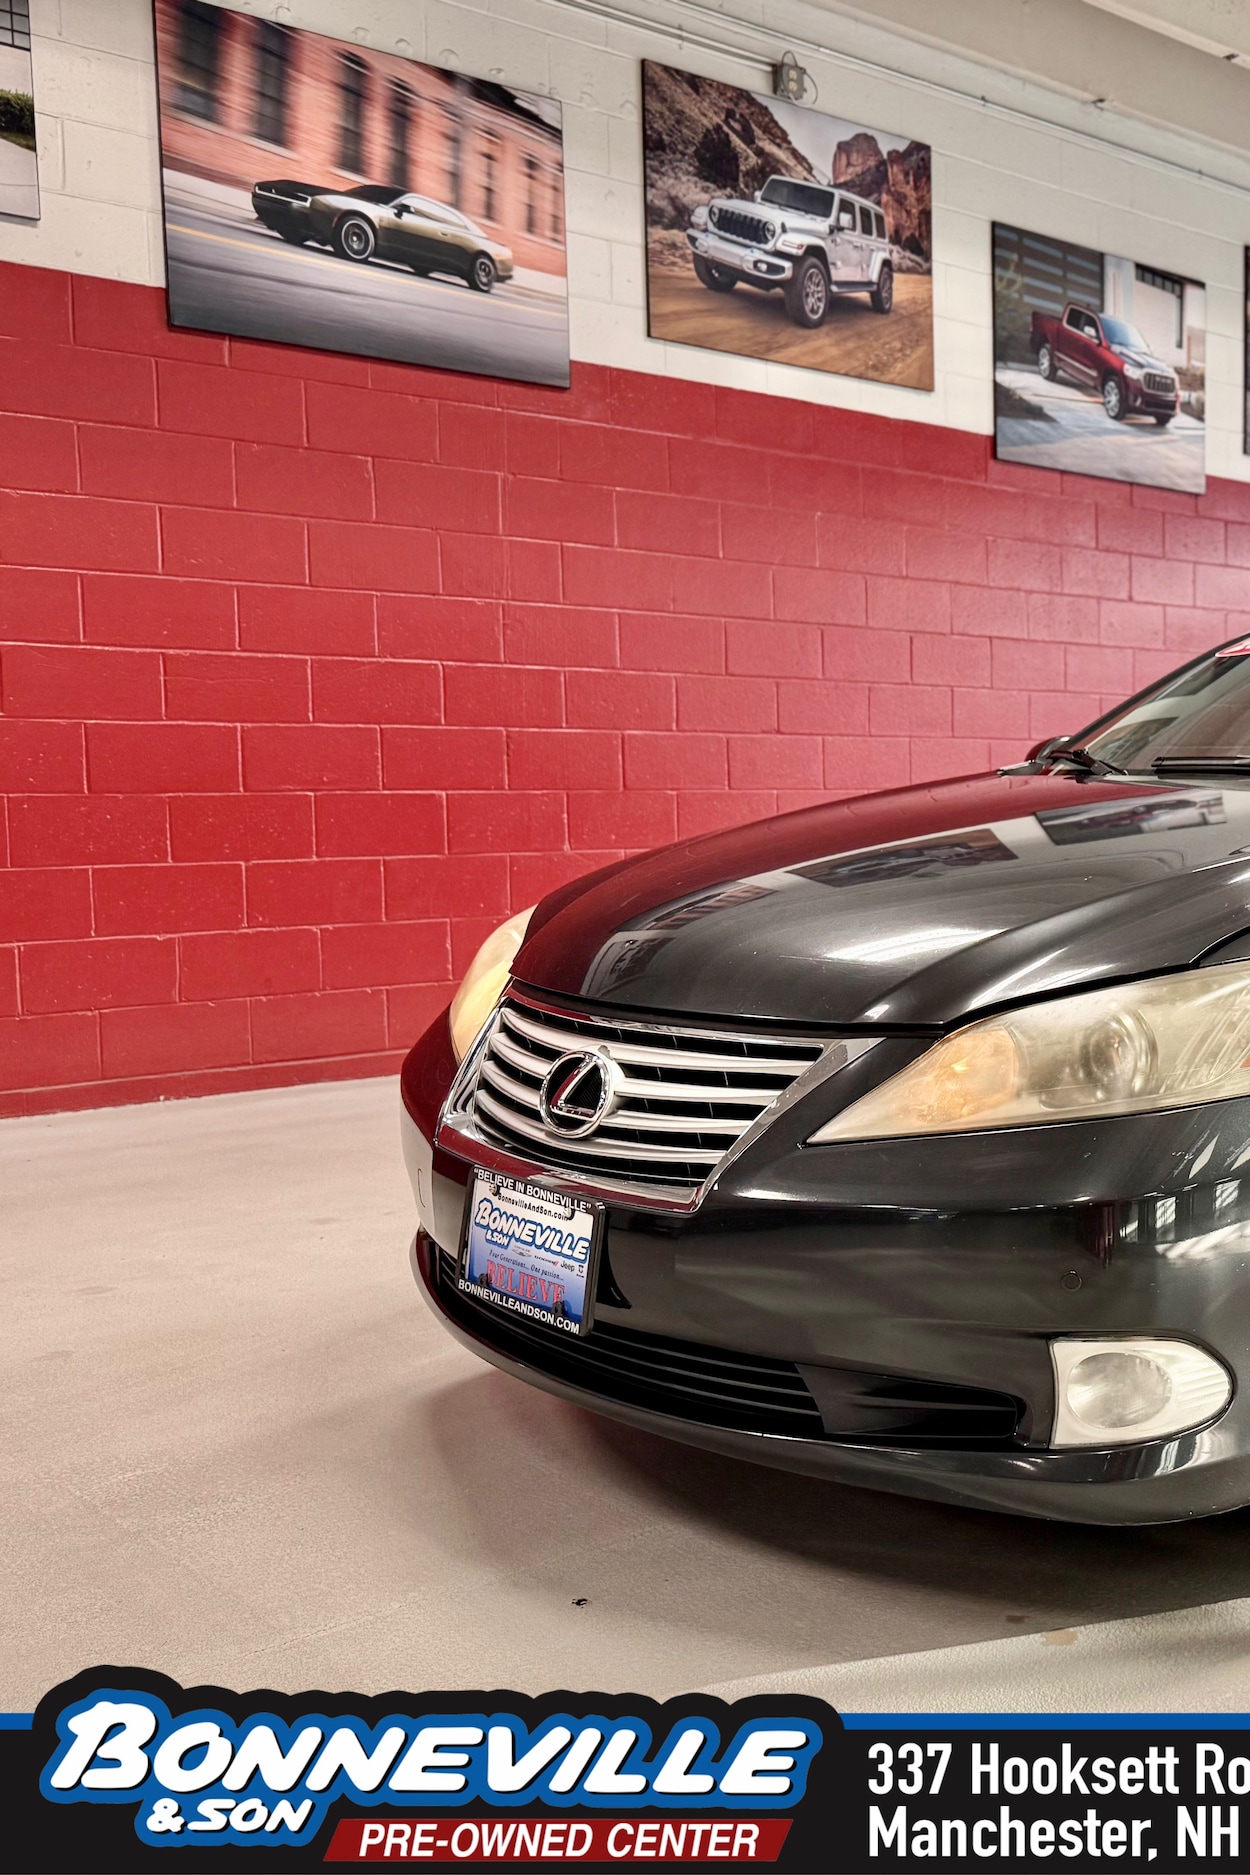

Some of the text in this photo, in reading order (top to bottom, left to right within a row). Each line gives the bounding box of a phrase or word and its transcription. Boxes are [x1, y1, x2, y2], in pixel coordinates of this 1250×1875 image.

[515, 1181, 525, 1194] IN
[475, 1200, 589, 1261] BONNEVILLE
[458, 1279, 580, 1335] BONNEVILLEANDSON.COM
[486, 1260, 566, 1304] BELIEVE
